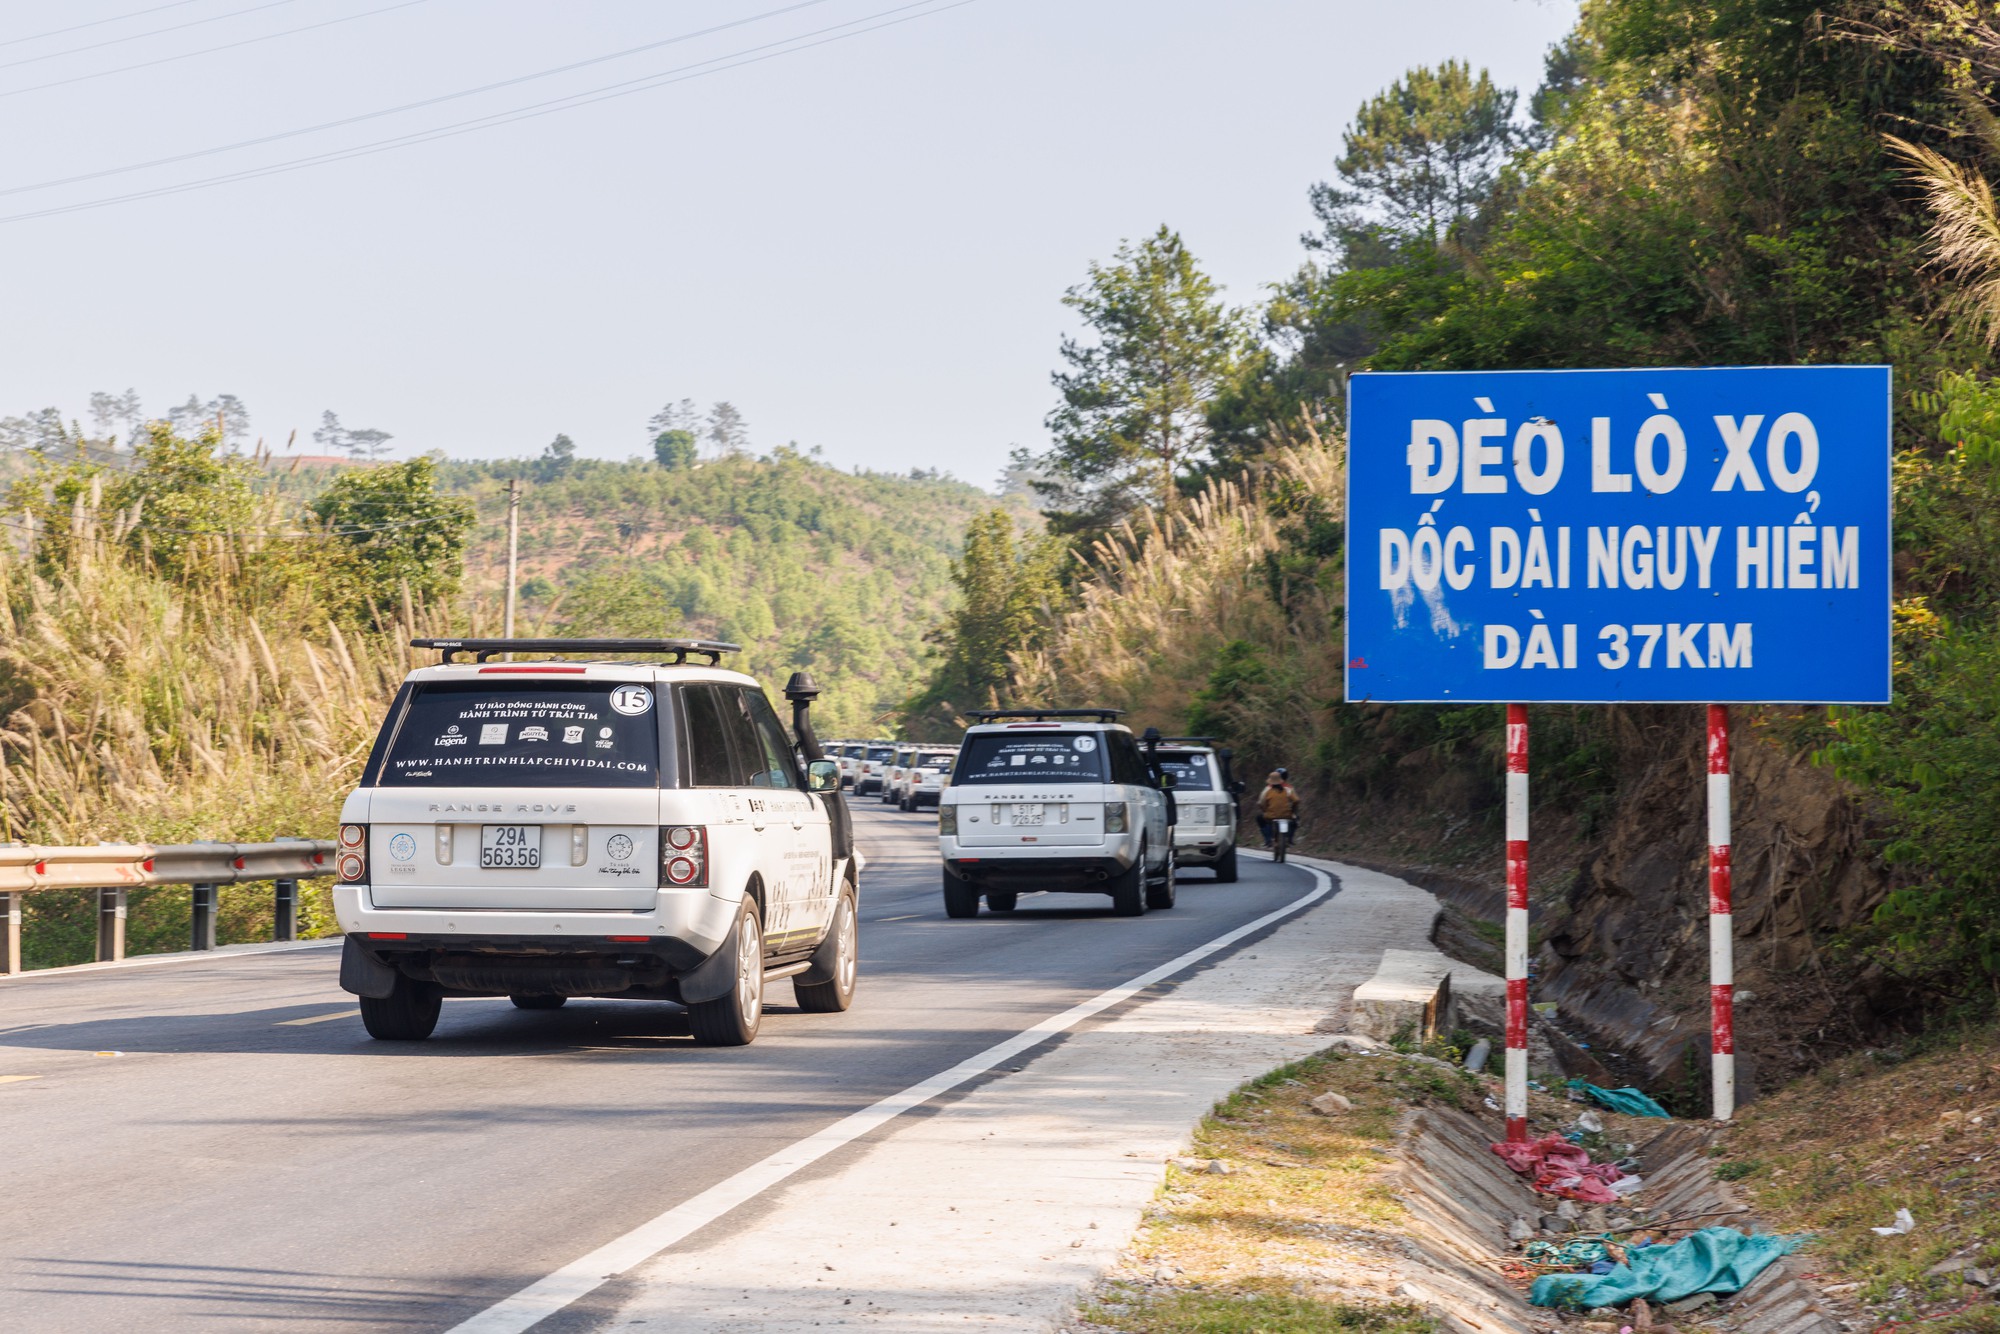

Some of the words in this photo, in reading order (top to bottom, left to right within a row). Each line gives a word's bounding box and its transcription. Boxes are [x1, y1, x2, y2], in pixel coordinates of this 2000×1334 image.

[1406, 396, 1565, 496] ĐÈO
[1591, 393, 1688, 494] LÒ
[1711, 411, 1820, 493] XO
[1379, 499, 1476, 591] DỐC
[1490, 508, 1571, 589] DÀI
[1587, 524, 1722, 591] NGUY
[1736, 491, 1860, 590] HIỂM
[1483, 609, 1578, 670] DÀI
[1597, 622, 1753, 670] 37KM
[619, 691, 647, 708] 15
[459, 710, 490, 719] HÀNH
[549, 710, 574, 718] TRÁI
[577, 711, 598, 720] TIM
[434, 736, 468, 747] Legend
[1078, 739, 1093, 749] 17
[396, 756, 648, 772] WWW.HANHTRINHLAPCHIVIDAI.COM
[428, 804, 503, 812] RANGE
[517, 804, 577, 812] ROVE
[1019, 804, 1035, 815] 51F
[495, 827, 527, 846] 29A
[482, 847, 539, 866] 563.56
